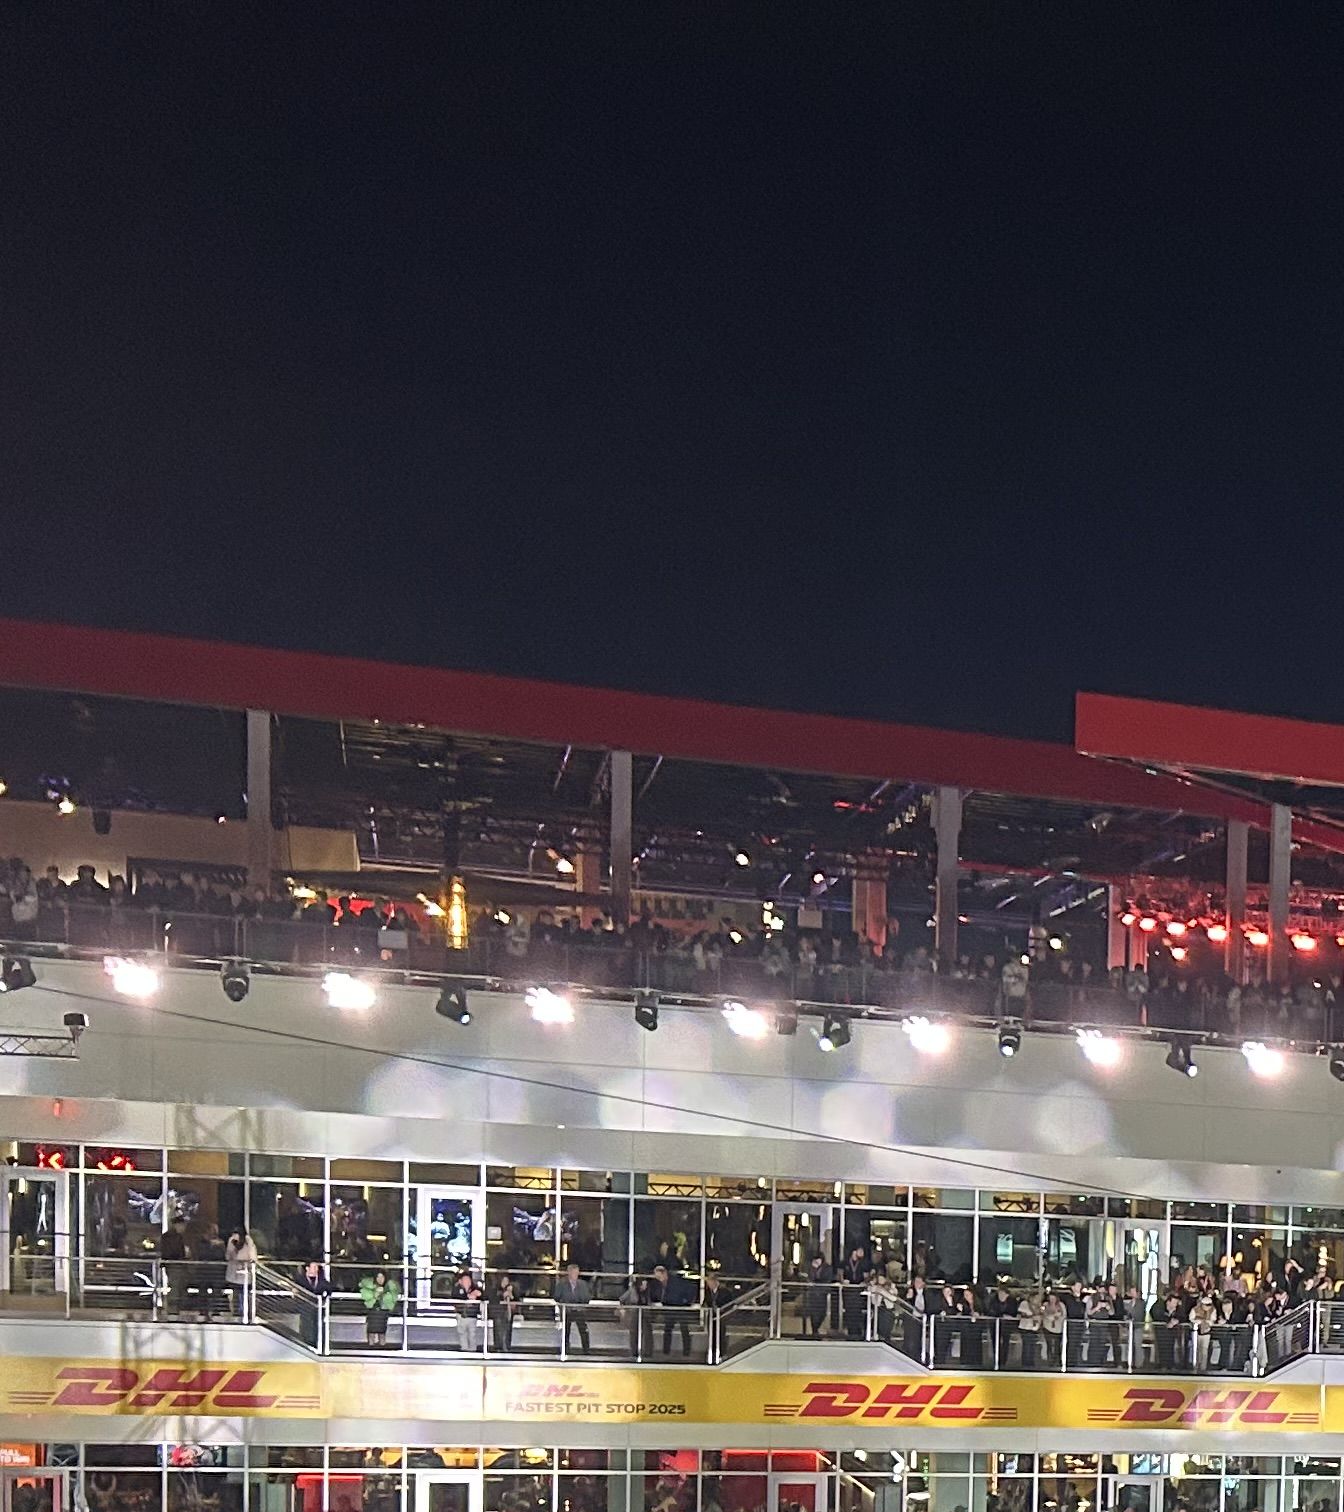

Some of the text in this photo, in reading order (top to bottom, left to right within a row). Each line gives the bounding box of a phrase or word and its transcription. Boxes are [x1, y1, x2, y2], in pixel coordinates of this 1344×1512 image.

[52, 1367, 279, 1408] DHL
[801, 1383, 986, 1419] DHL
[505, 1402, 686, 1415] FASTEST PIT STOP 2025
[1123, 1389, 1290, 1424] DHL
